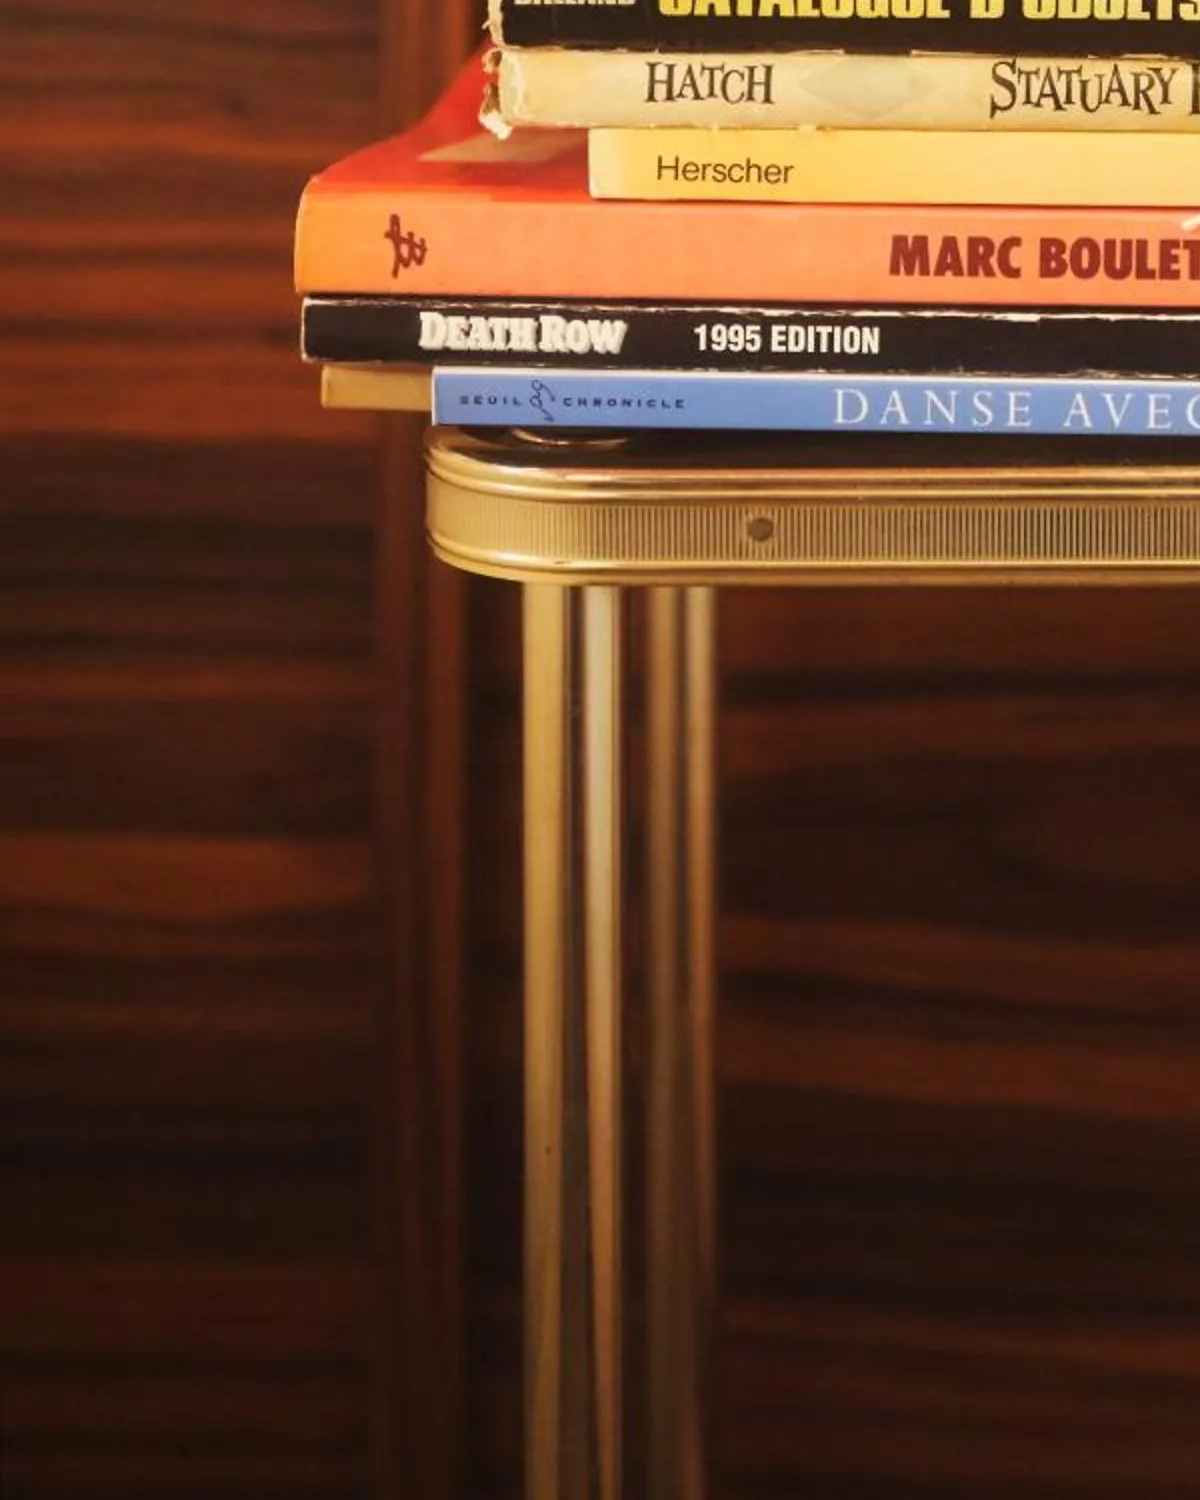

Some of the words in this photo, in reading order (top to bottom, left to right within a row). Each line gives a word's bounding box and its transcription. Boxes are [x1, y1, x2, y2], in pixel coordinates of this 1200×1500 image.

[644, 62, 774, 105] HATCH
[990, 59, 1179, 119] STATUARY
[657, 155, 795, 184] Herscher
[889, 235, 1021, 278] MARC
[418, 311, 538, 352] DEATH
[538, 314, 628, 355] ROW
[694, 324, 762, 352] 1995
[771, 325, 880, 354] EDITION
[459, 395, 522, 406] SEUIL
[563, 397, 686, 408] CHRONICLE
[834, 388, 1032, 428] DANSE
